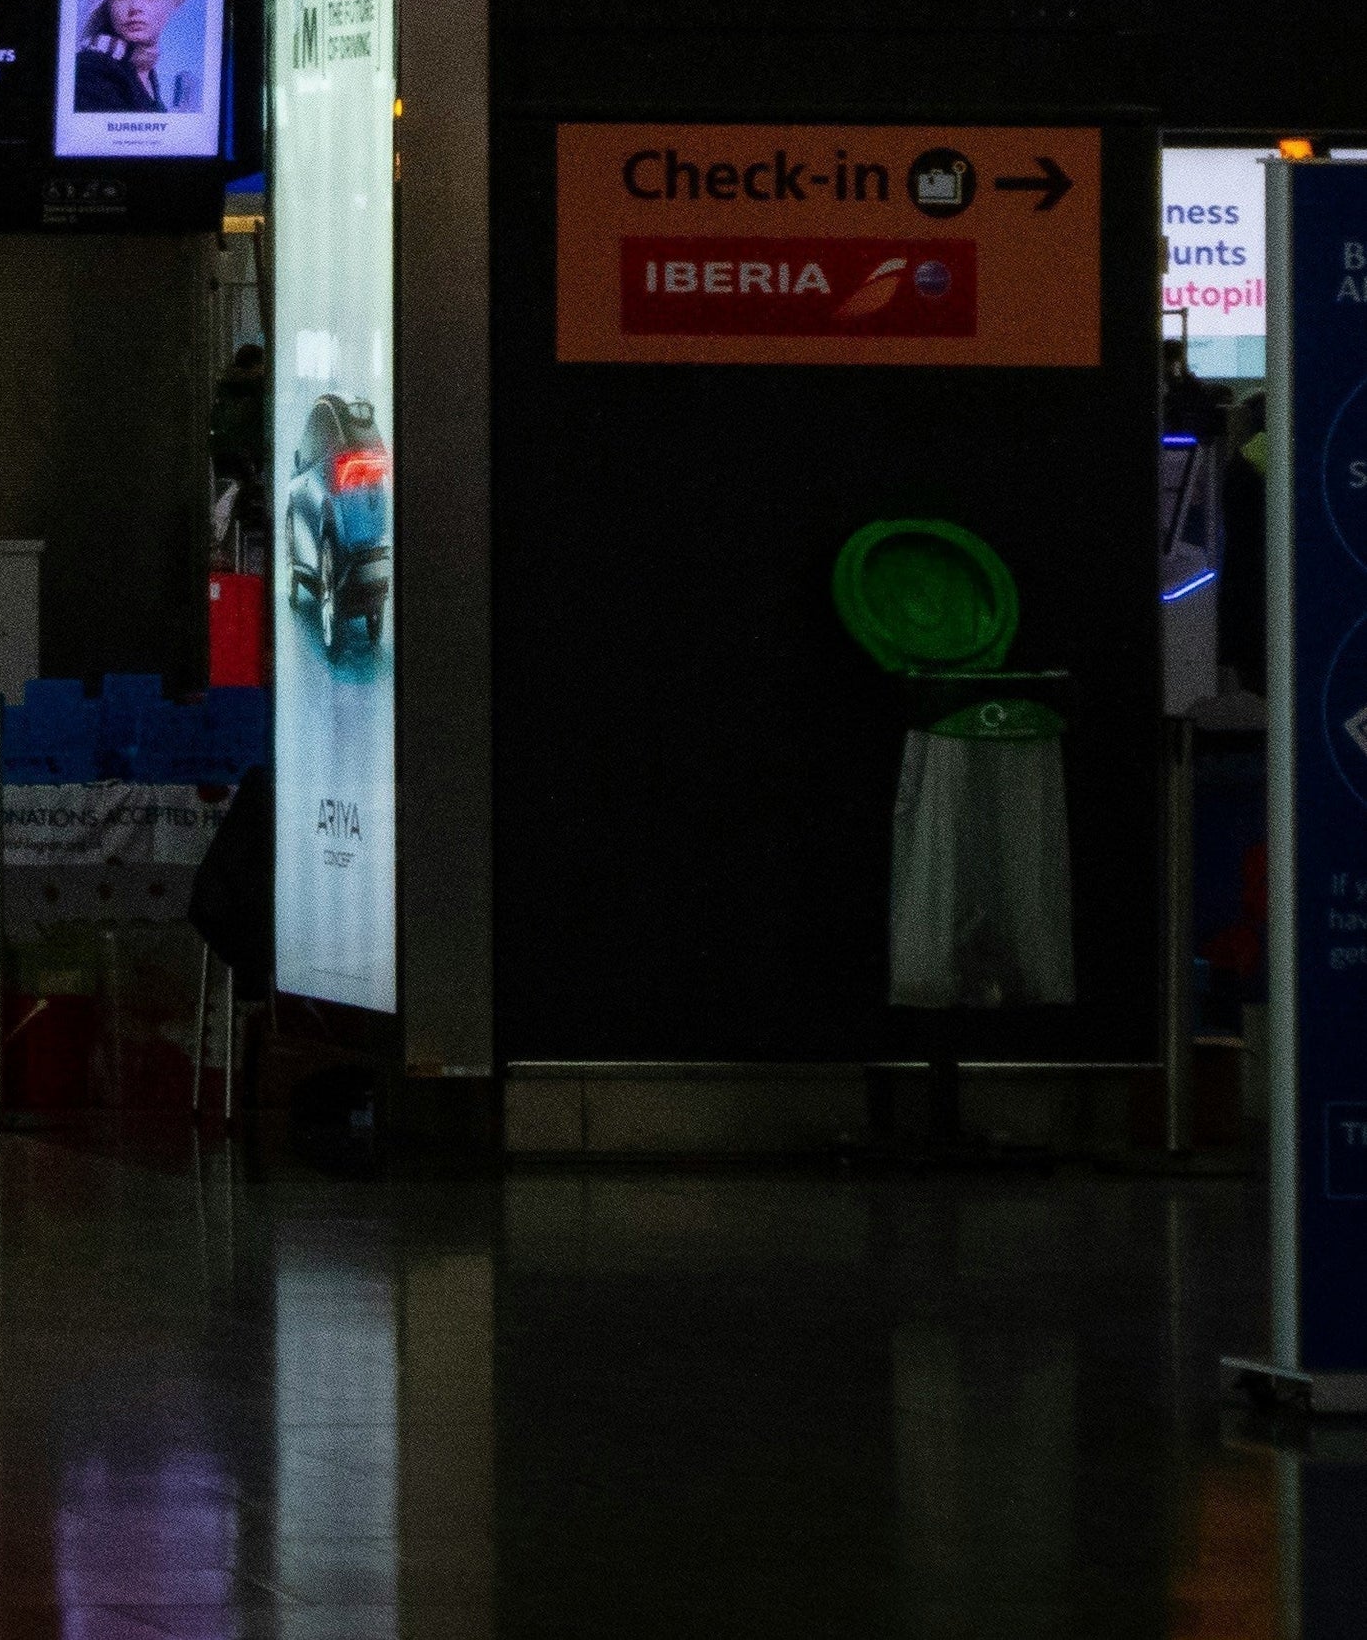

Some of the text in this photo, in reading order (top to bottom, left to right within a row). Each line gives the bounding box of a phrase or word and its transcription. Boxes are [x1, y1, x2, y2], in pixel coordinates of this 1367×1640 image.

[107, 122, 168, 132] BURBERRY
[622, 150, 890, 201] Check-in
[1166, 241, 1246, 266] unts
[645, 261, 832, 294] IBERIA
